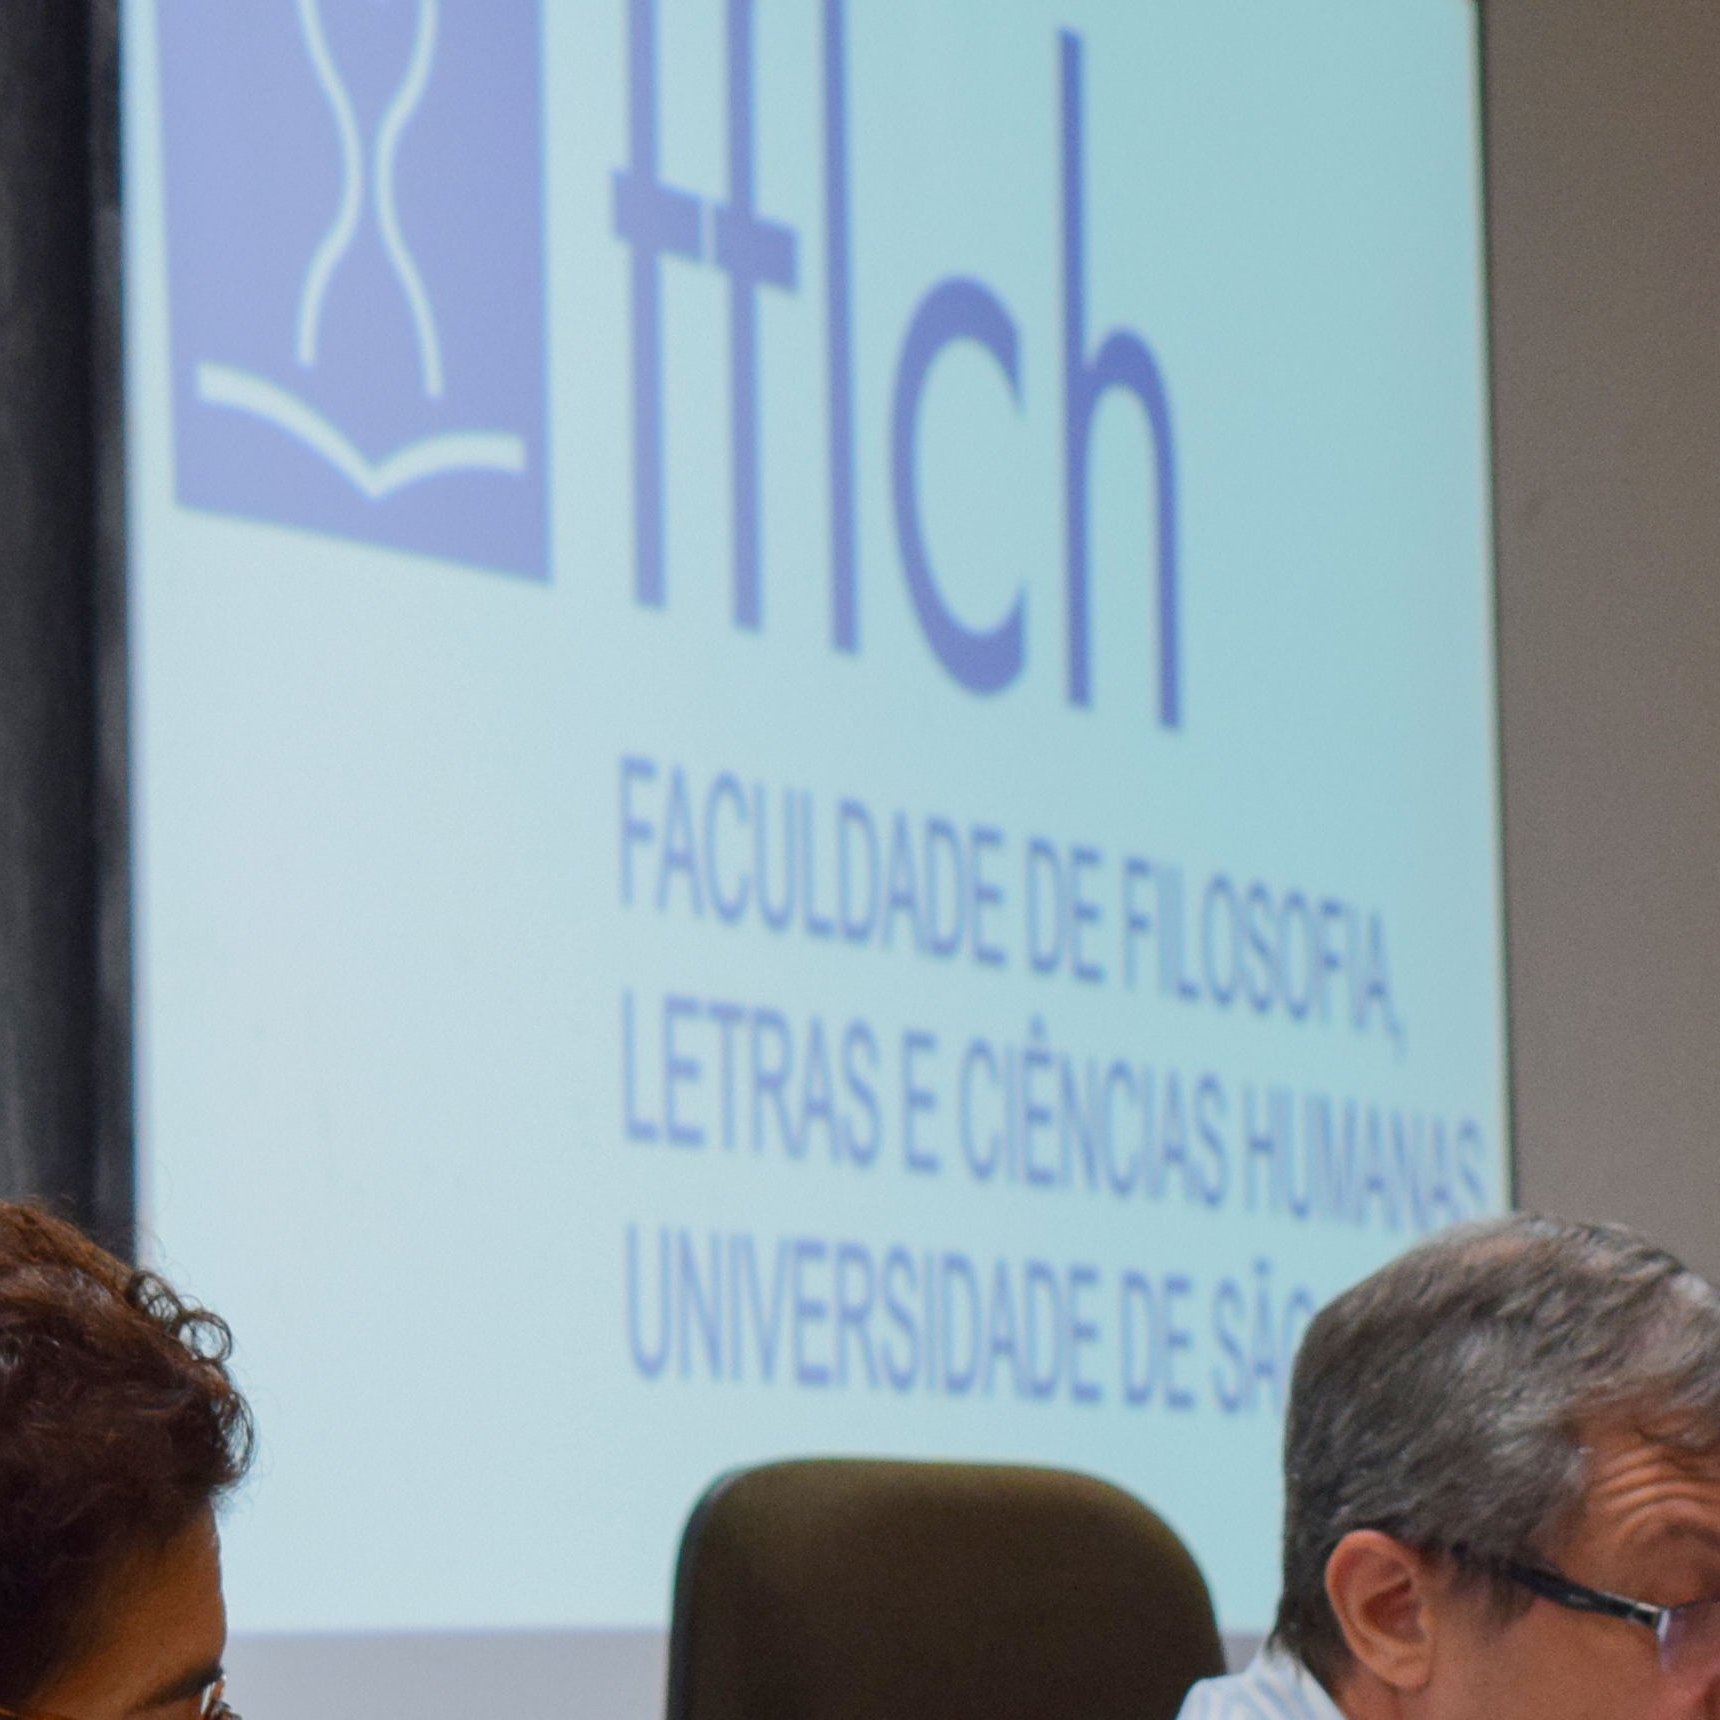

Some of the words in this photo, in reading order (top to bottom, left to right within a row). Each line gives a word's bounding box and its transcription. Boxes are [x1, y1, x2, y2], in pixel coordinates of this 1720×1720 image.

[618, 752, 1008, 970] FACULDADE
[1025, 834, 1107, 986] DE
[1122, 854, 1408, 1064] FILOSOFIA,
[621, 987, 881, 1170] LETRAS
[901, 1028, 942, 1177] E
[958, 1012, 1230, 1212] CIÊNCIAS
[1242, 1078, 1488, 1235] HUMANAS
[624, 1222, 1102, 1408] UNIVERSIDADE
[1119, 1268, 1196, 1414] DE
